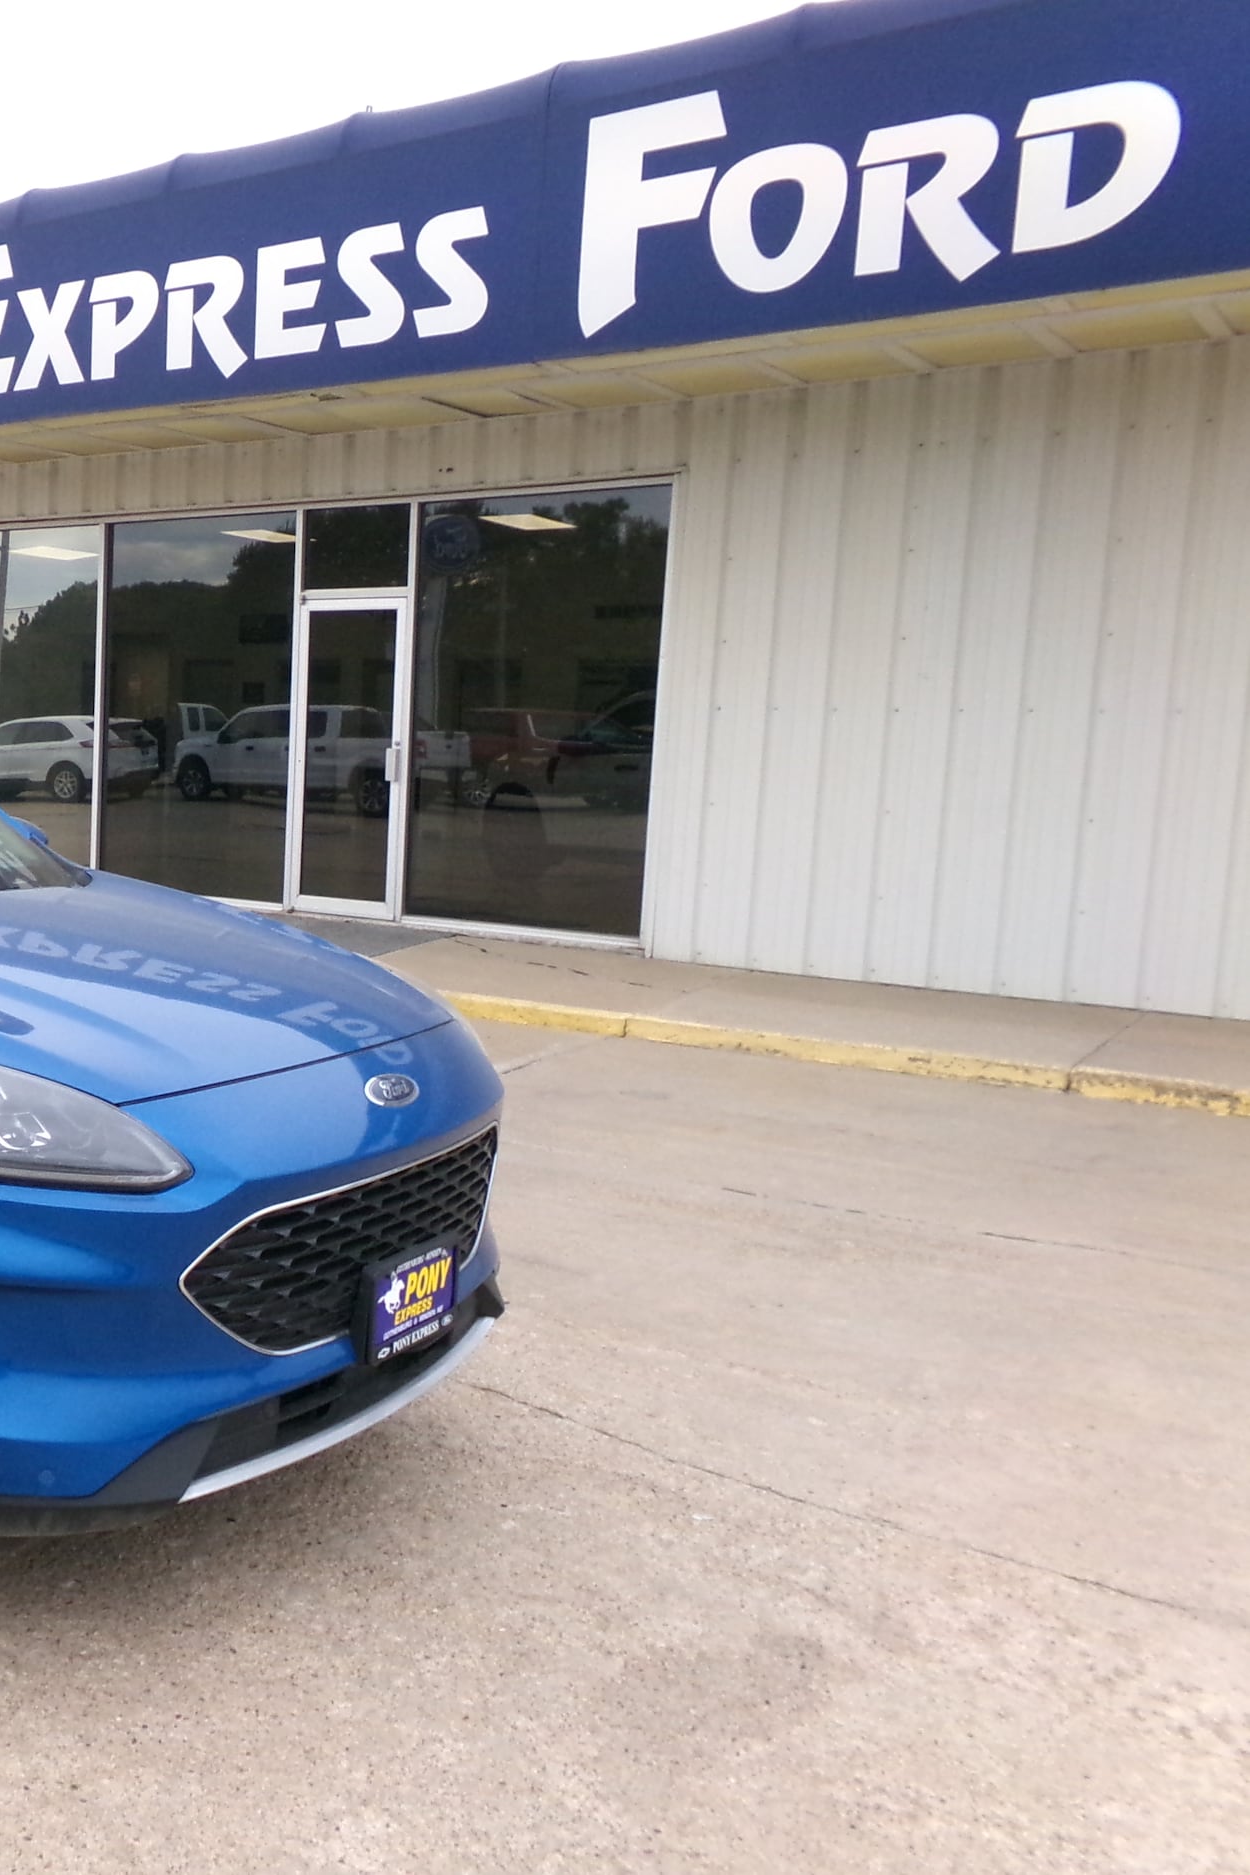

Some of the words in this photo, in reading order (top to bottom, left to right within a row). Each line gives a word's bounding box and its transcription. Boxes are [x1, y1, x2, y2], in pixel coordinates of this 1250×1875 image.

[577, 79, 1182, 338] FORD
[405, 1255, 452, 1305] PONY
[394, 1296, 433, 1326] EXPRESS
[393, 1336, 412, 1354] PONY
[411, 1320, 440, 1343] EXPRESS
